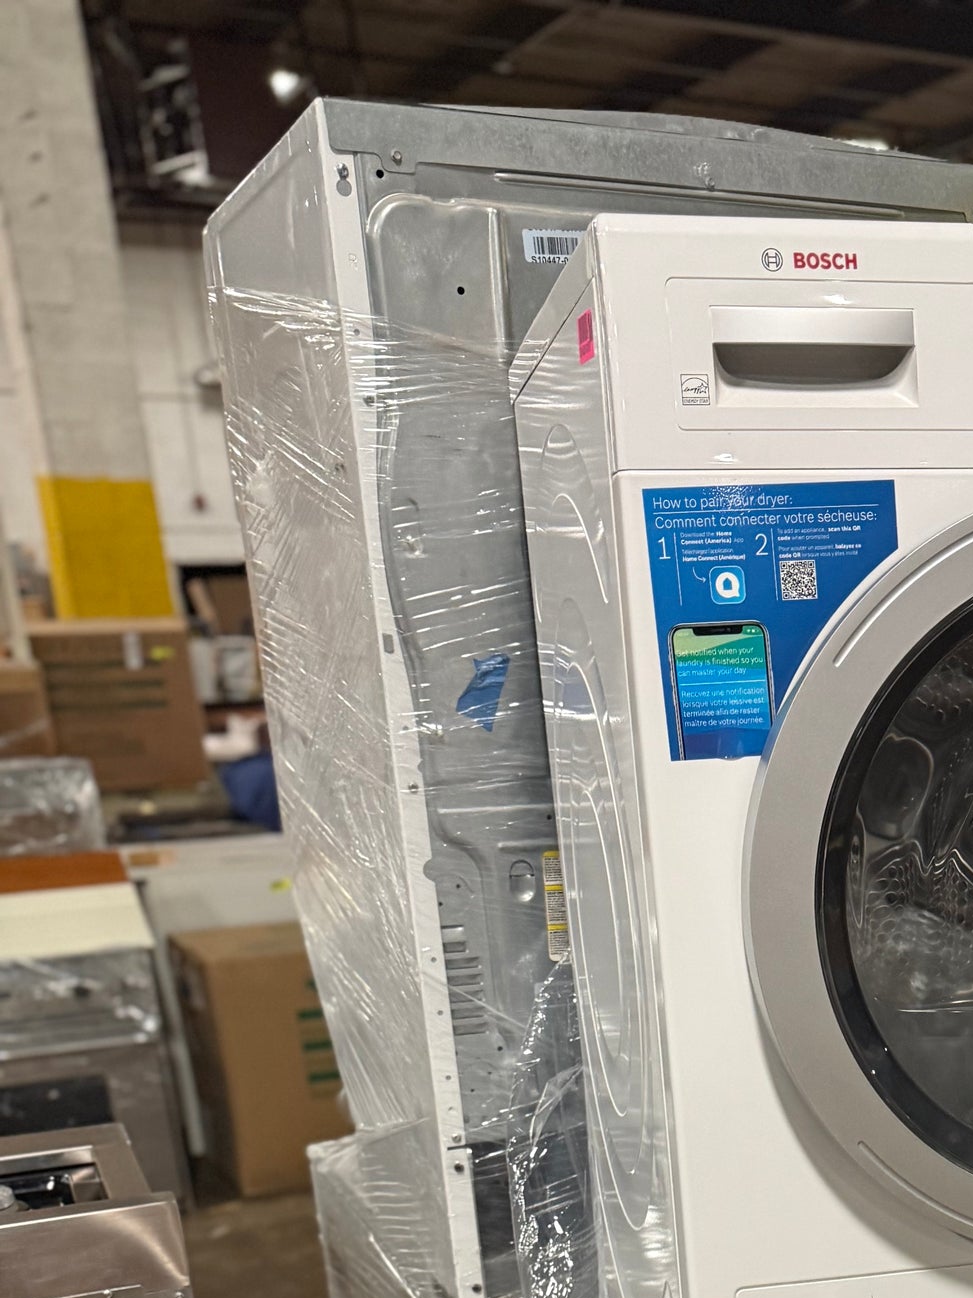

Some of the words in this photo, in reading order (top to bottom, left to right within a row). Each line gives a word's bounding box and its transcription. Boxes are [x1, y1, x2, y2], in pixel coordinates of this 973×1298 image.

[793, 252, 857, 270] BOSCH
[653, 497, 681, 509] How
[685, 497, 697, 508] to
[700, 496, 722, 510] pair
[727, 495, 754, 510] your
[757, 493, 793, 508] dryer:
[655, 515, 717, 529] Comment
[719, 512, 781, 527] connecter
[784, 512, 814, 523] votre
[817, 509, 877, 522] sécheuse:
[658, 537, 671, 560] 1
[754, 533, 769, 557] 2
[717, 647, 737, 655] when
[739, 647, 754, 655] your
[712, 657, 740, 665] finished
